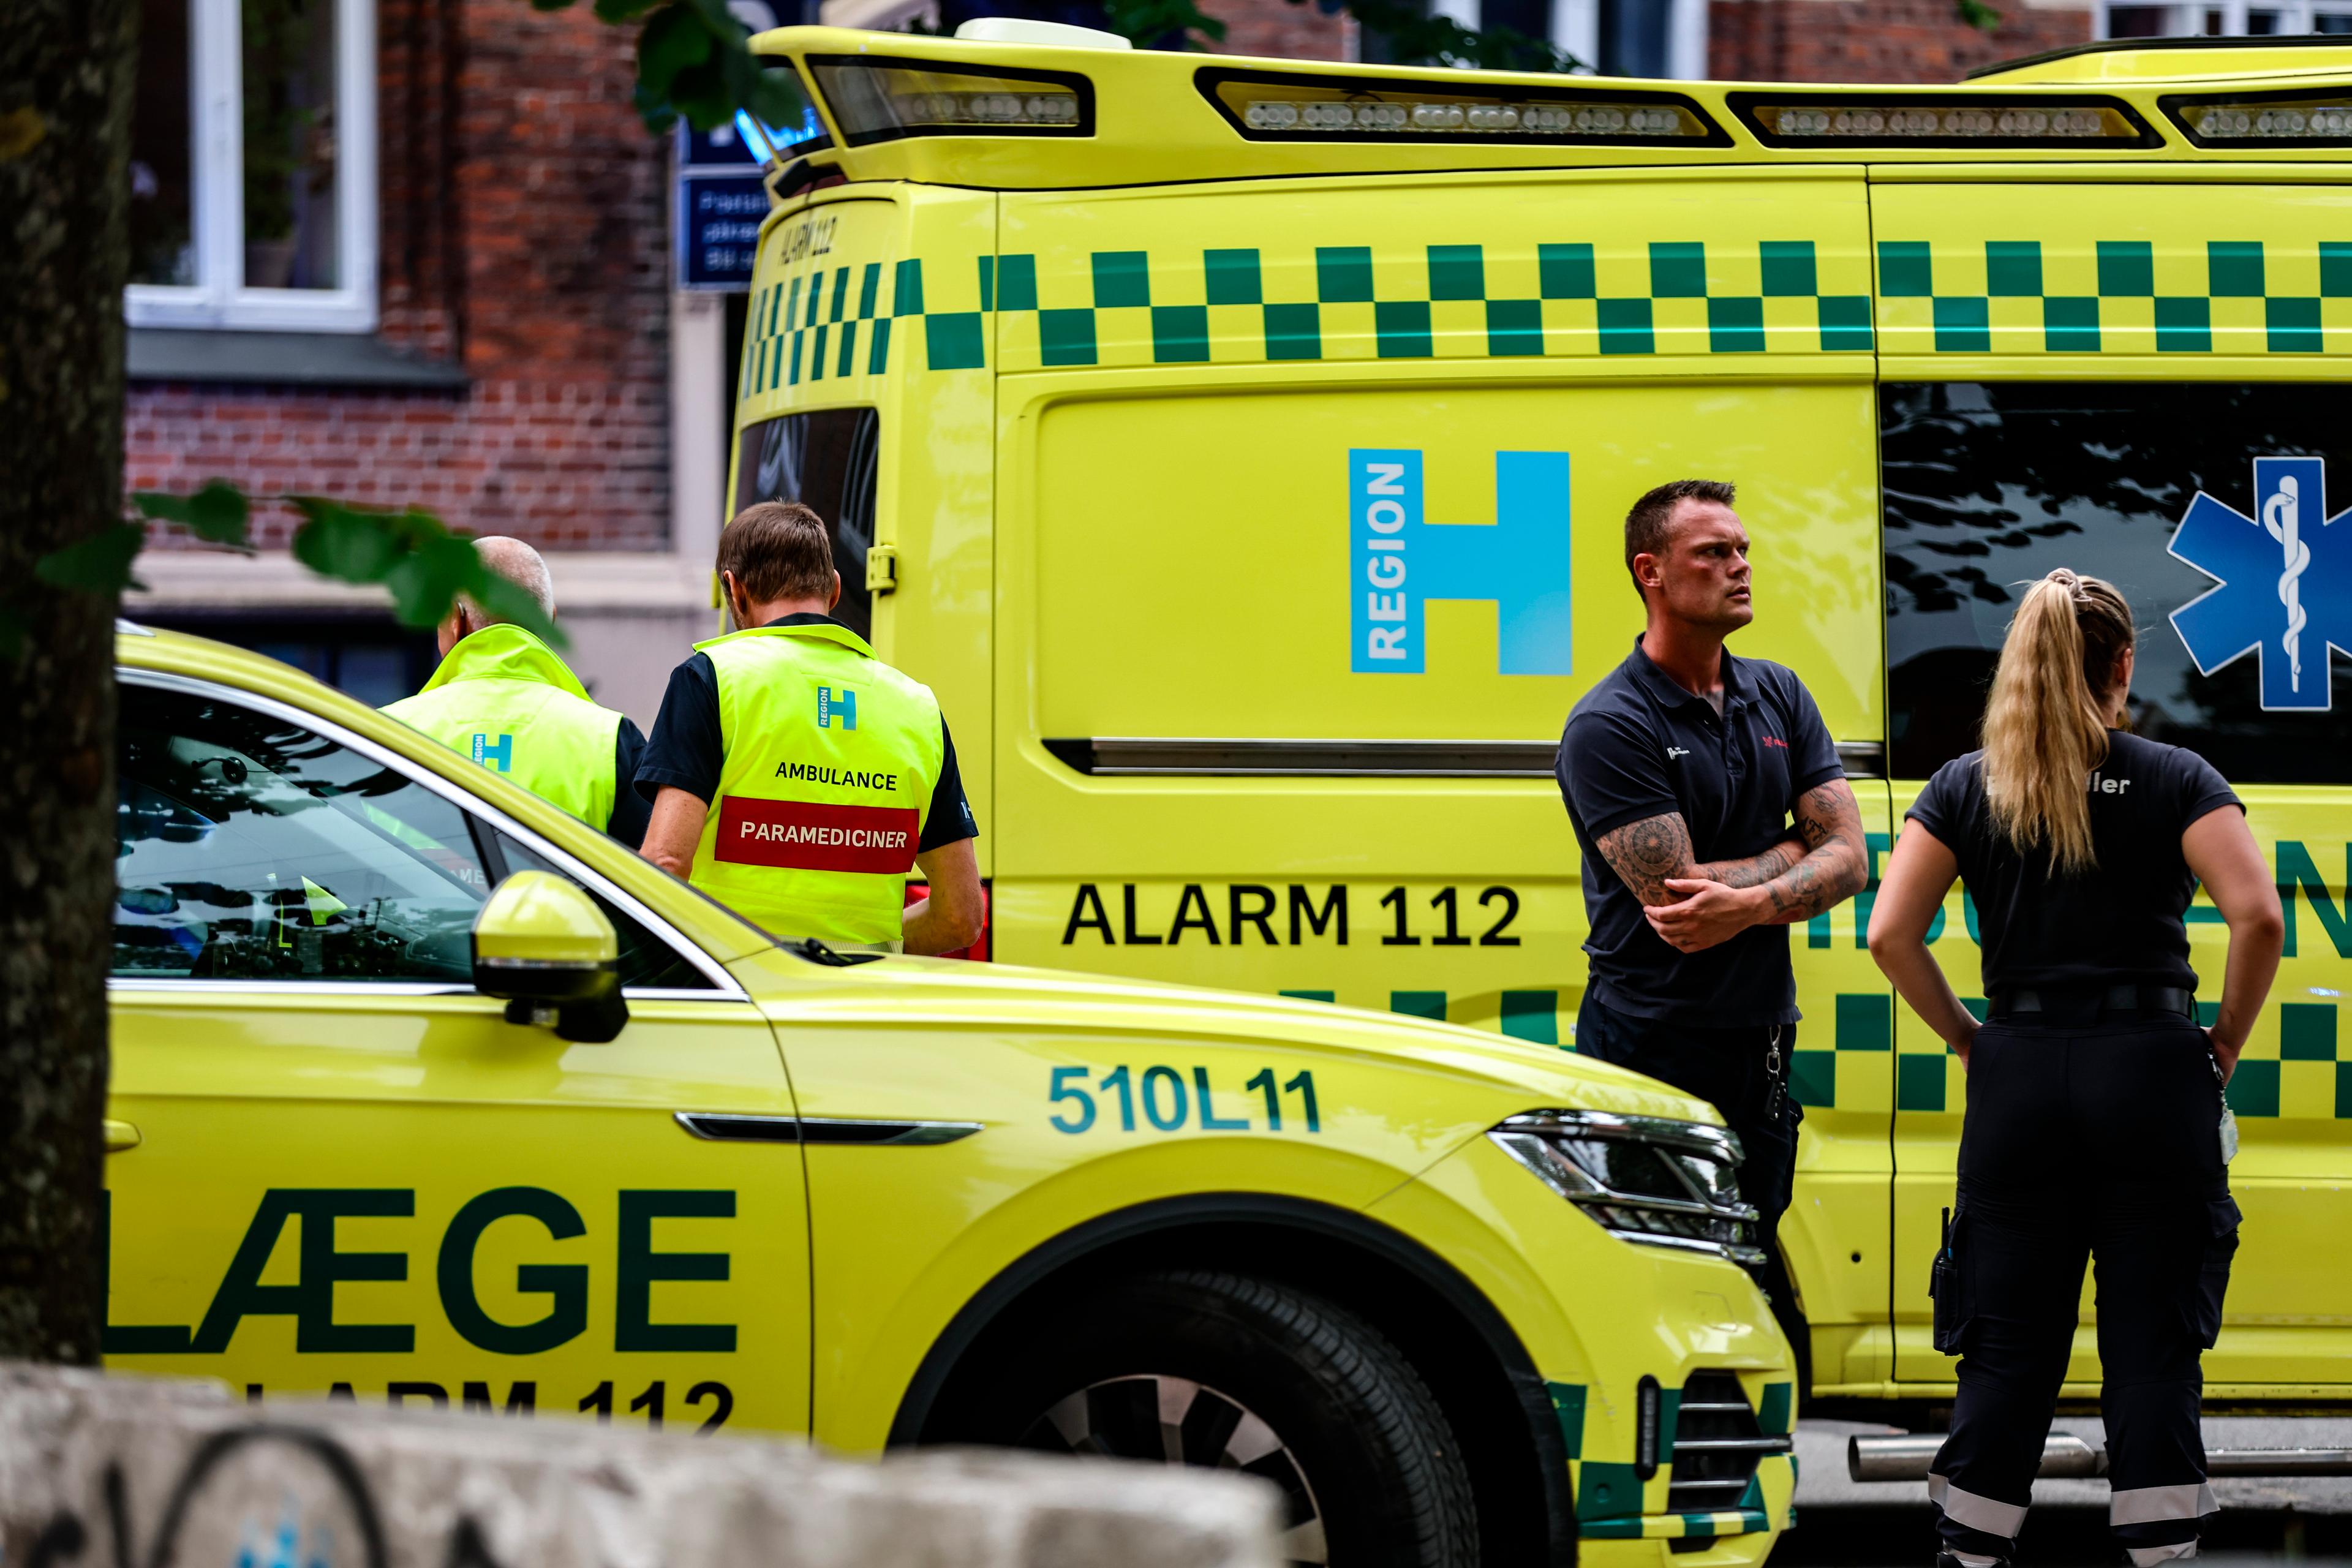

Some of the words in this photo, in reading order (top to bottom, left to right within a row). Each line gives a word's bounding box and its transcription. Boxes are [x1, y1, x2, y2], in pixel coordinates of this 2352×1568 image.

[1349, 448, 1572, 675] H
[1366, 463, 1406, 660] REGION
[818, 686, 856, 731] H
[475, 735, 483, 764] EGION
[775, 761, 897, 791] AMBULANCE
[740, 821, 907, 848] PARAMEDICINER
[1061, 883, 1348, 946] ALARM
[1380, 886, 1521, 946] 112
[1049, 1064, 1321, 1134] 510L11
[102, 1185, 738, 1356] LÆGE
